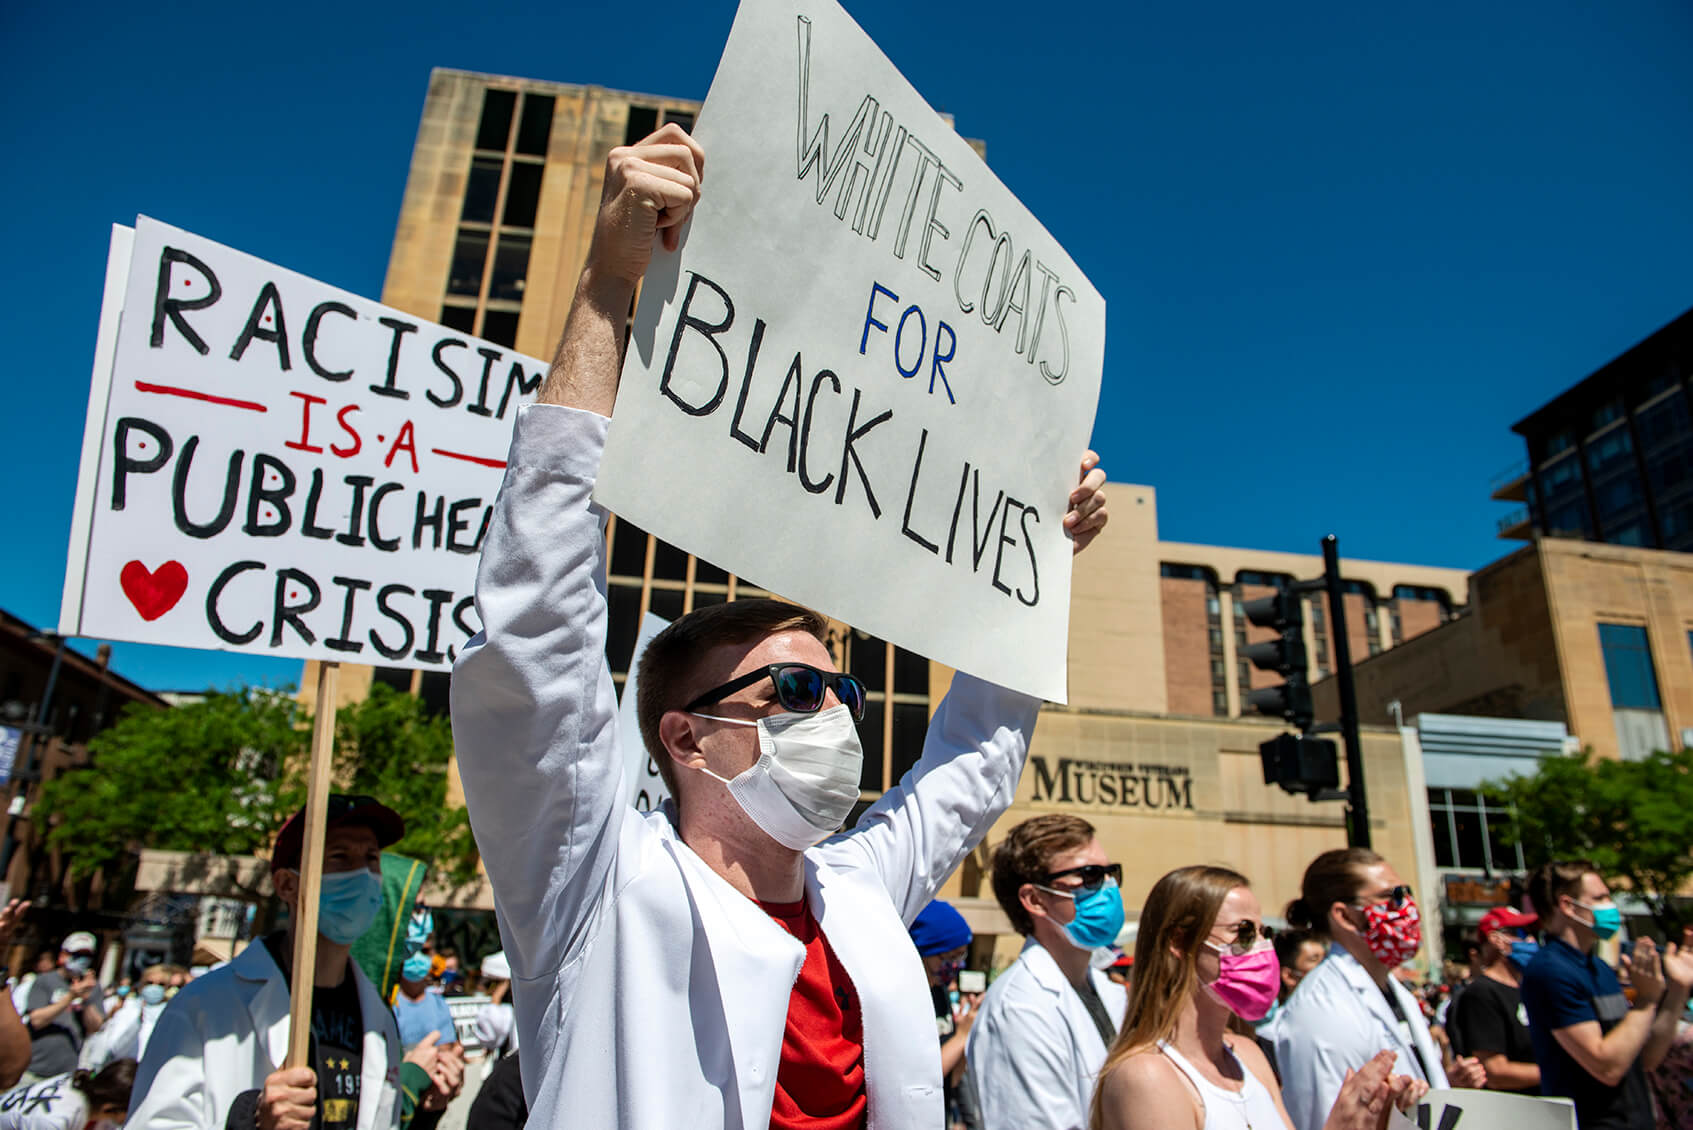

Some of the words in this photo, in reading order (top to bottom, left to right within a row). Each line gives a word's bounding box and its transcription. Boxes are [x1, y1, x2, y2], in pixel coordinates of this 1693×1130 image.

[797, 15, 963, 282] WHITE
[954, 209, 1076, 385] COATS
[859, 281, 957, 405] FOR
[111, 417, 404, 554] PUBLIC
[659, 270, 893, 520] BLACK
[901, 429, 1041, 607] LIVES
[206, 560, 475, 664] CRISIS
[1031, 756, 1193, 809] MUSEUM
